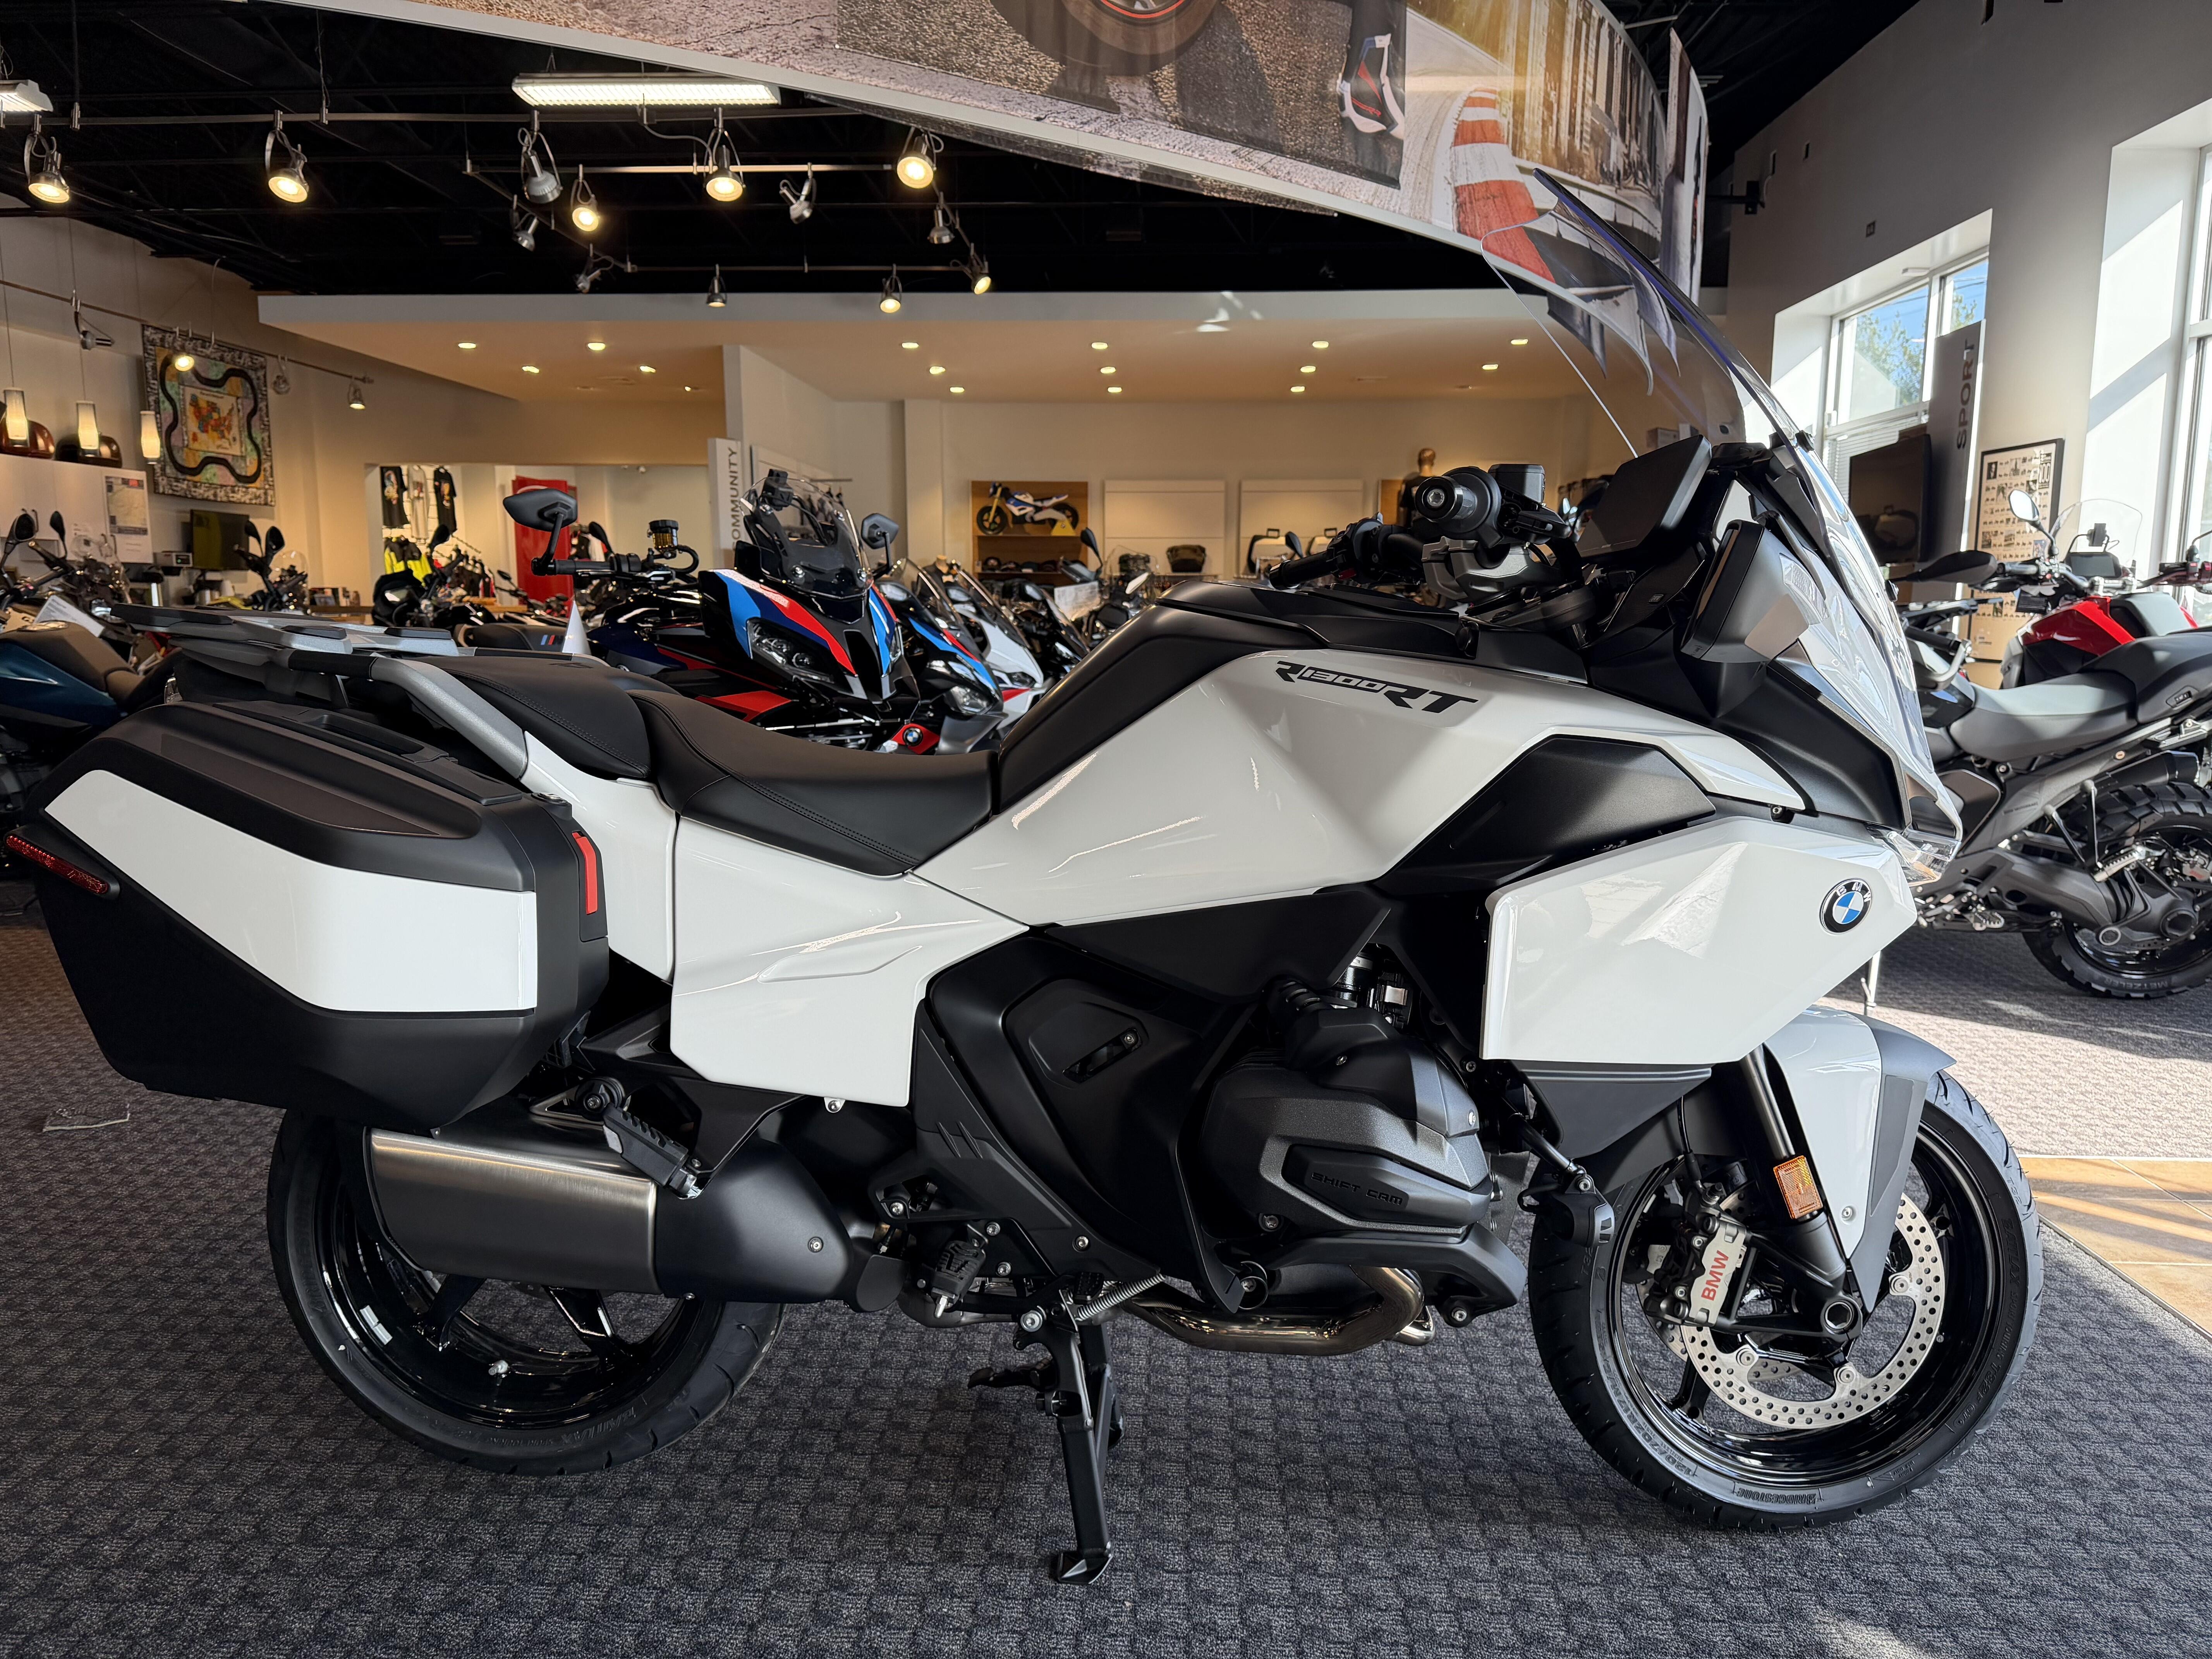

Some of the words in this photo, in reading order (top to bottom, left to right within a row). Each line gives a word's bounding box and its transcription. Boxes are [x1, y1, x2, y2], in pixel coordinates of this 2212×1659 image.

[1957, 339, 1977, 450] SPORT
[728, 447, 740, 547] OMMUNITY
[1836, 882, 1872, 902] BMW
[2104, 978, 2168, 990] METZELER
[1311, 1172, 1360, 1192] SHIFT
[1366, 1189, 1403, 1206] CAM
[1701, 1250, 1729, 1301] BMW
[2009, 1291, 2019, 1320] SPORT
[1997, 1321, 2015, 1360] TOURING
[1736, 1488, 1816, 1504] BRIDGESTONE
